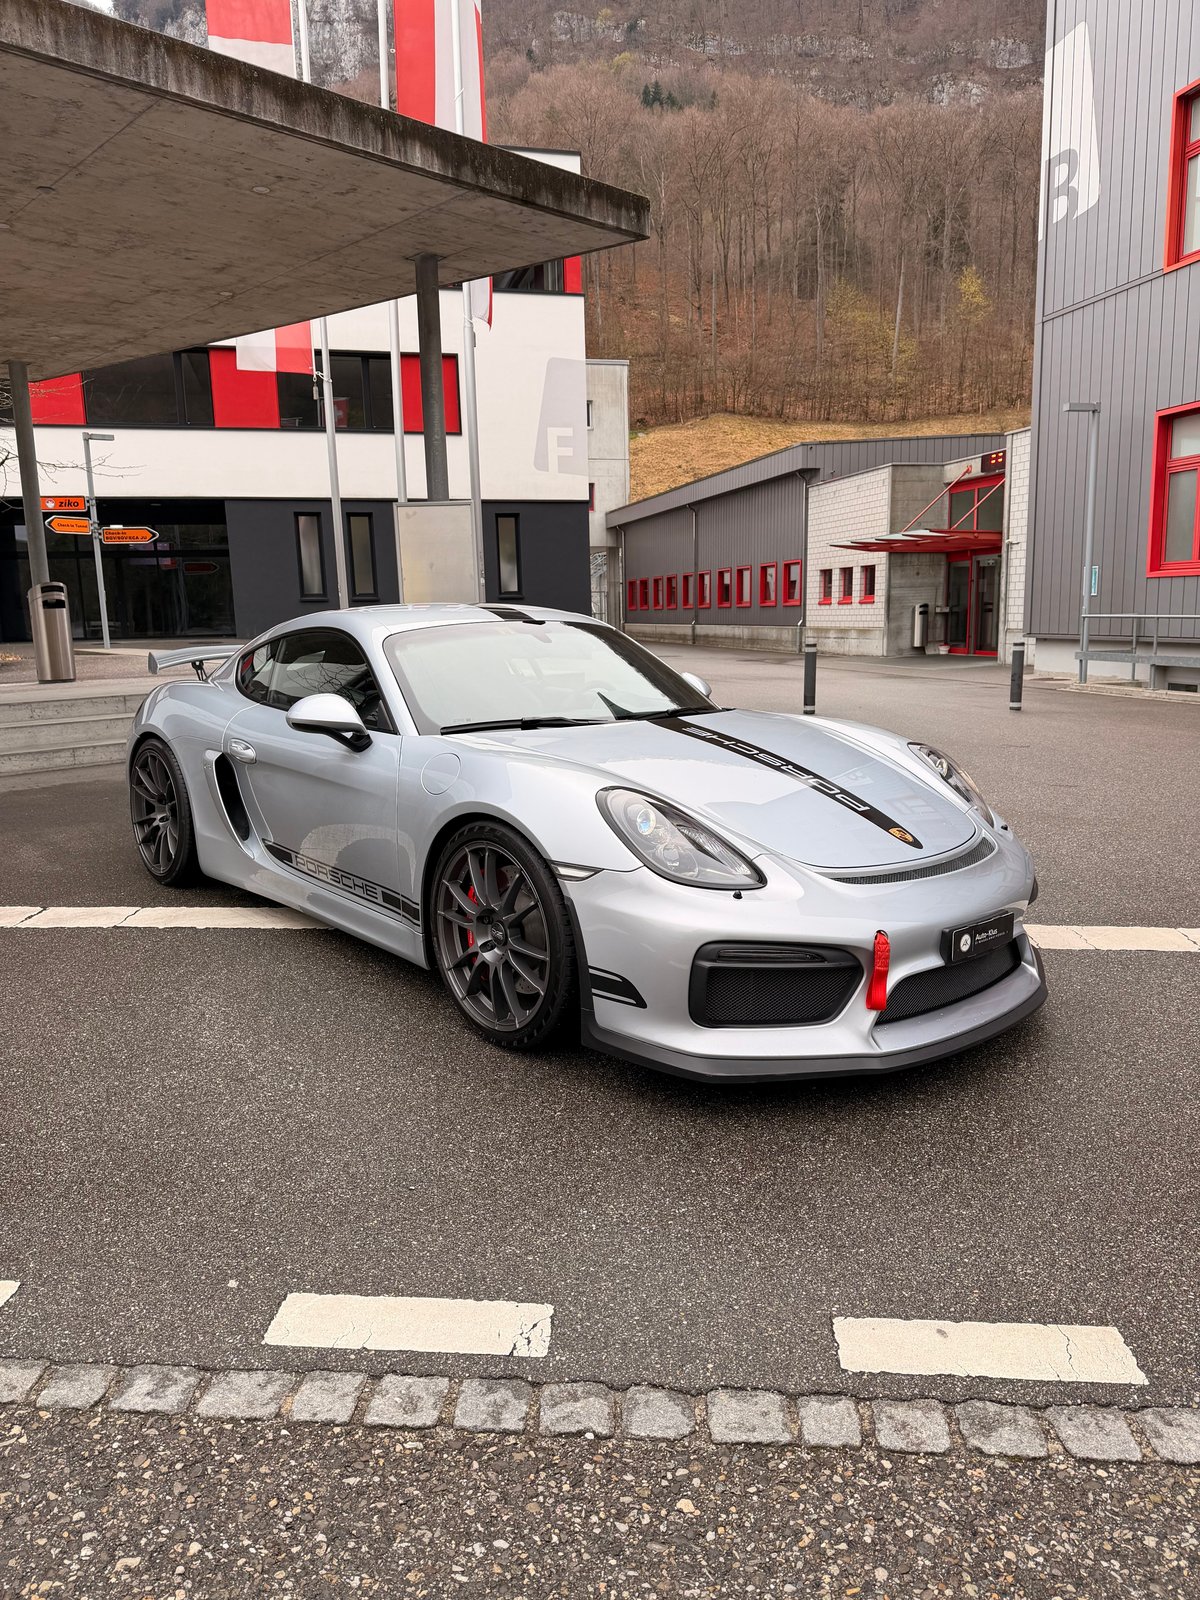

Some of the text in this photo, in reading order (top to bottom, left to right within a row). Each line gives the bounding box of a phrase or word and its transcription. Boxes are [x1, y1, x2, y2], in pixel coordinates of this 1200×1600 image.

[1043, 148, 1080, 230] B
[547, 426, 574, 473] F
[58, 499, 79, 508] ziko
[682, 726, 870, 812] PORSCHE
[295, 855, 379, 900] PORSCHE
[975, 929, 998, 940] Auto-Klus
